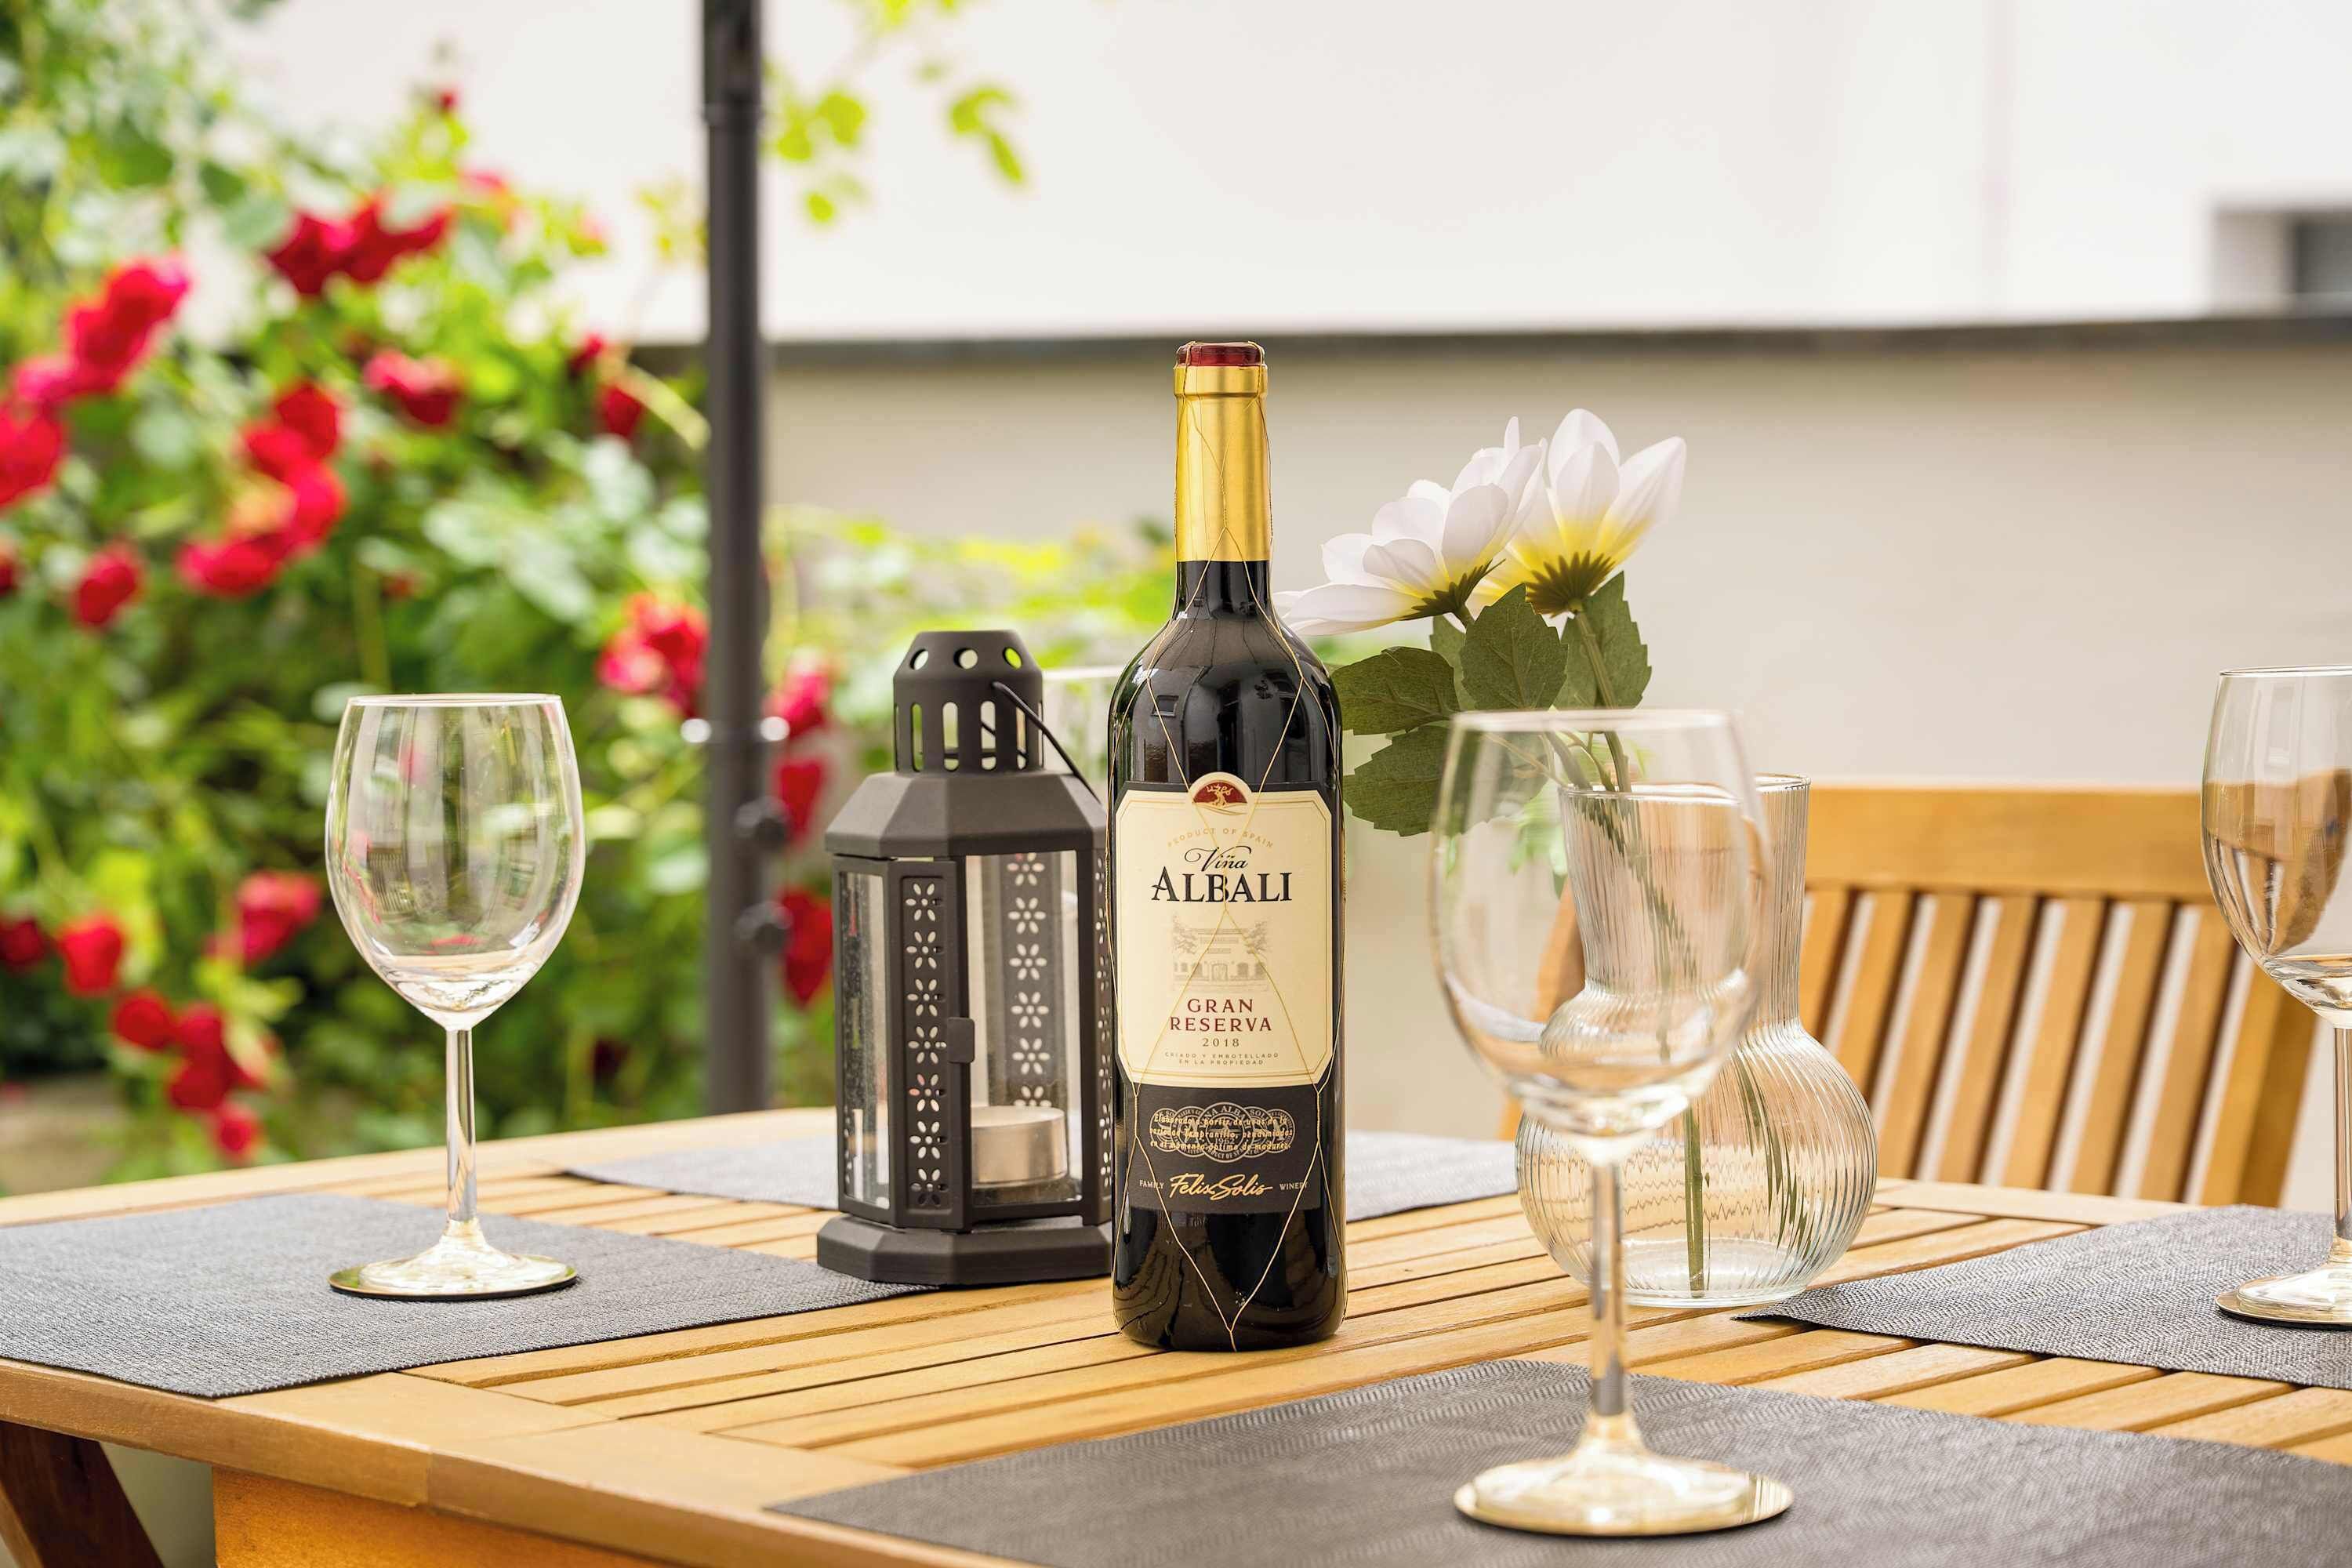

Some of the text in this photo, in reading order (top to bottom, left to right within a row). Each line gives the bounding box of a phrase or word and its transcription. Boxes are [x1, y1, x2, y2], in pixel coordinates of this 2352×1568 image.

[1167, 827, 1215, 847] PRODUCT
[1242, 830, 1273, 848] SPAIN
[1184, 845, 1252, 872] Viña
[1151, 866, 1292, 902] ALBALI
[1187, 998, 1254, 1013] GRAN
[1169, 1016, 1272, 1032] RESERVA
[1202, 1037, 1240, 1047] 2018
[1139, 1179, 1164, 1189] FAMILY
